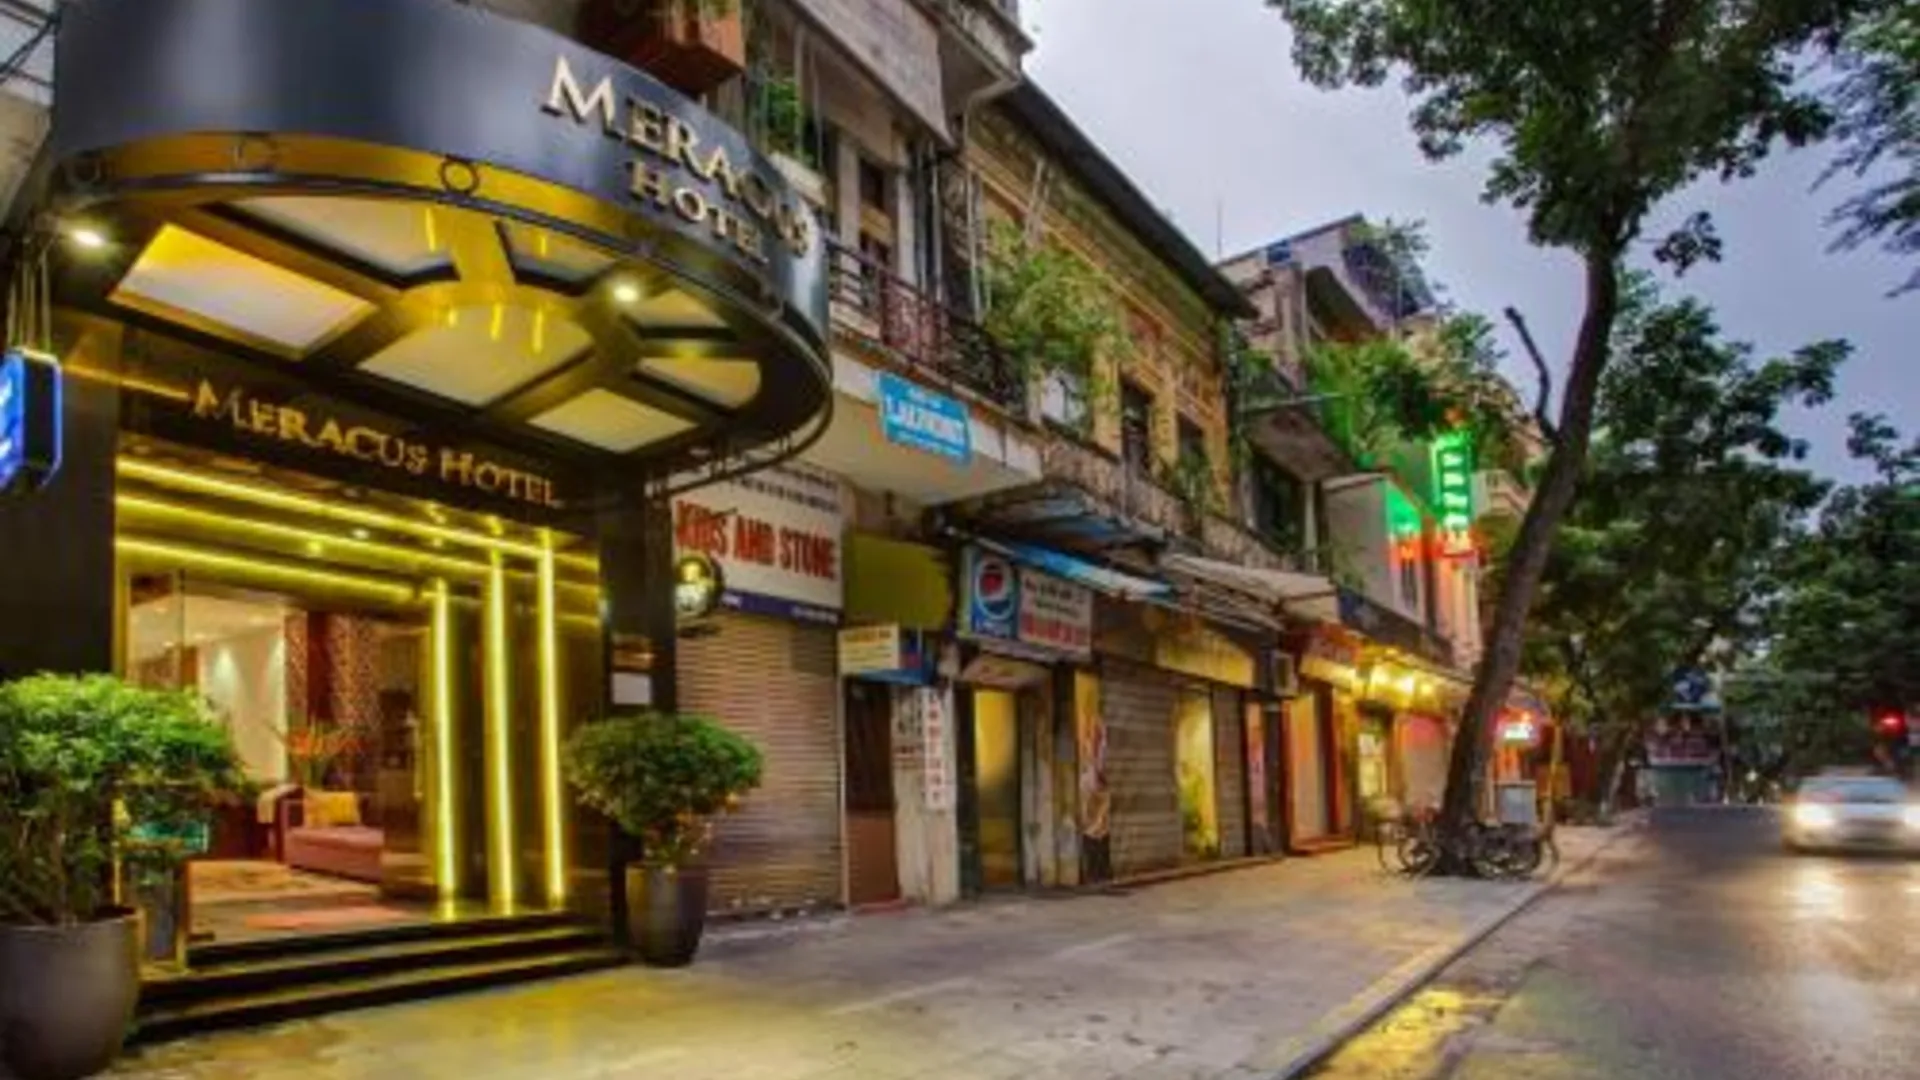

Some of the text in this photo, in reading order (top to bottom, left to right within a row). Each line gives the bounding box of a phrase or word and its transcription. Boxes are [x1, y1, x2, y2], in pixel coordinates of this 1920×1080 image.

[542, 55, 806, 258] MERACUS
[627, 159, 769, 265] HOTEL
[194, 378, 562, 508] MERACUS HOTEL
[733, 514, 775, 566] AND
[779, 526, 836, 581] STONE
